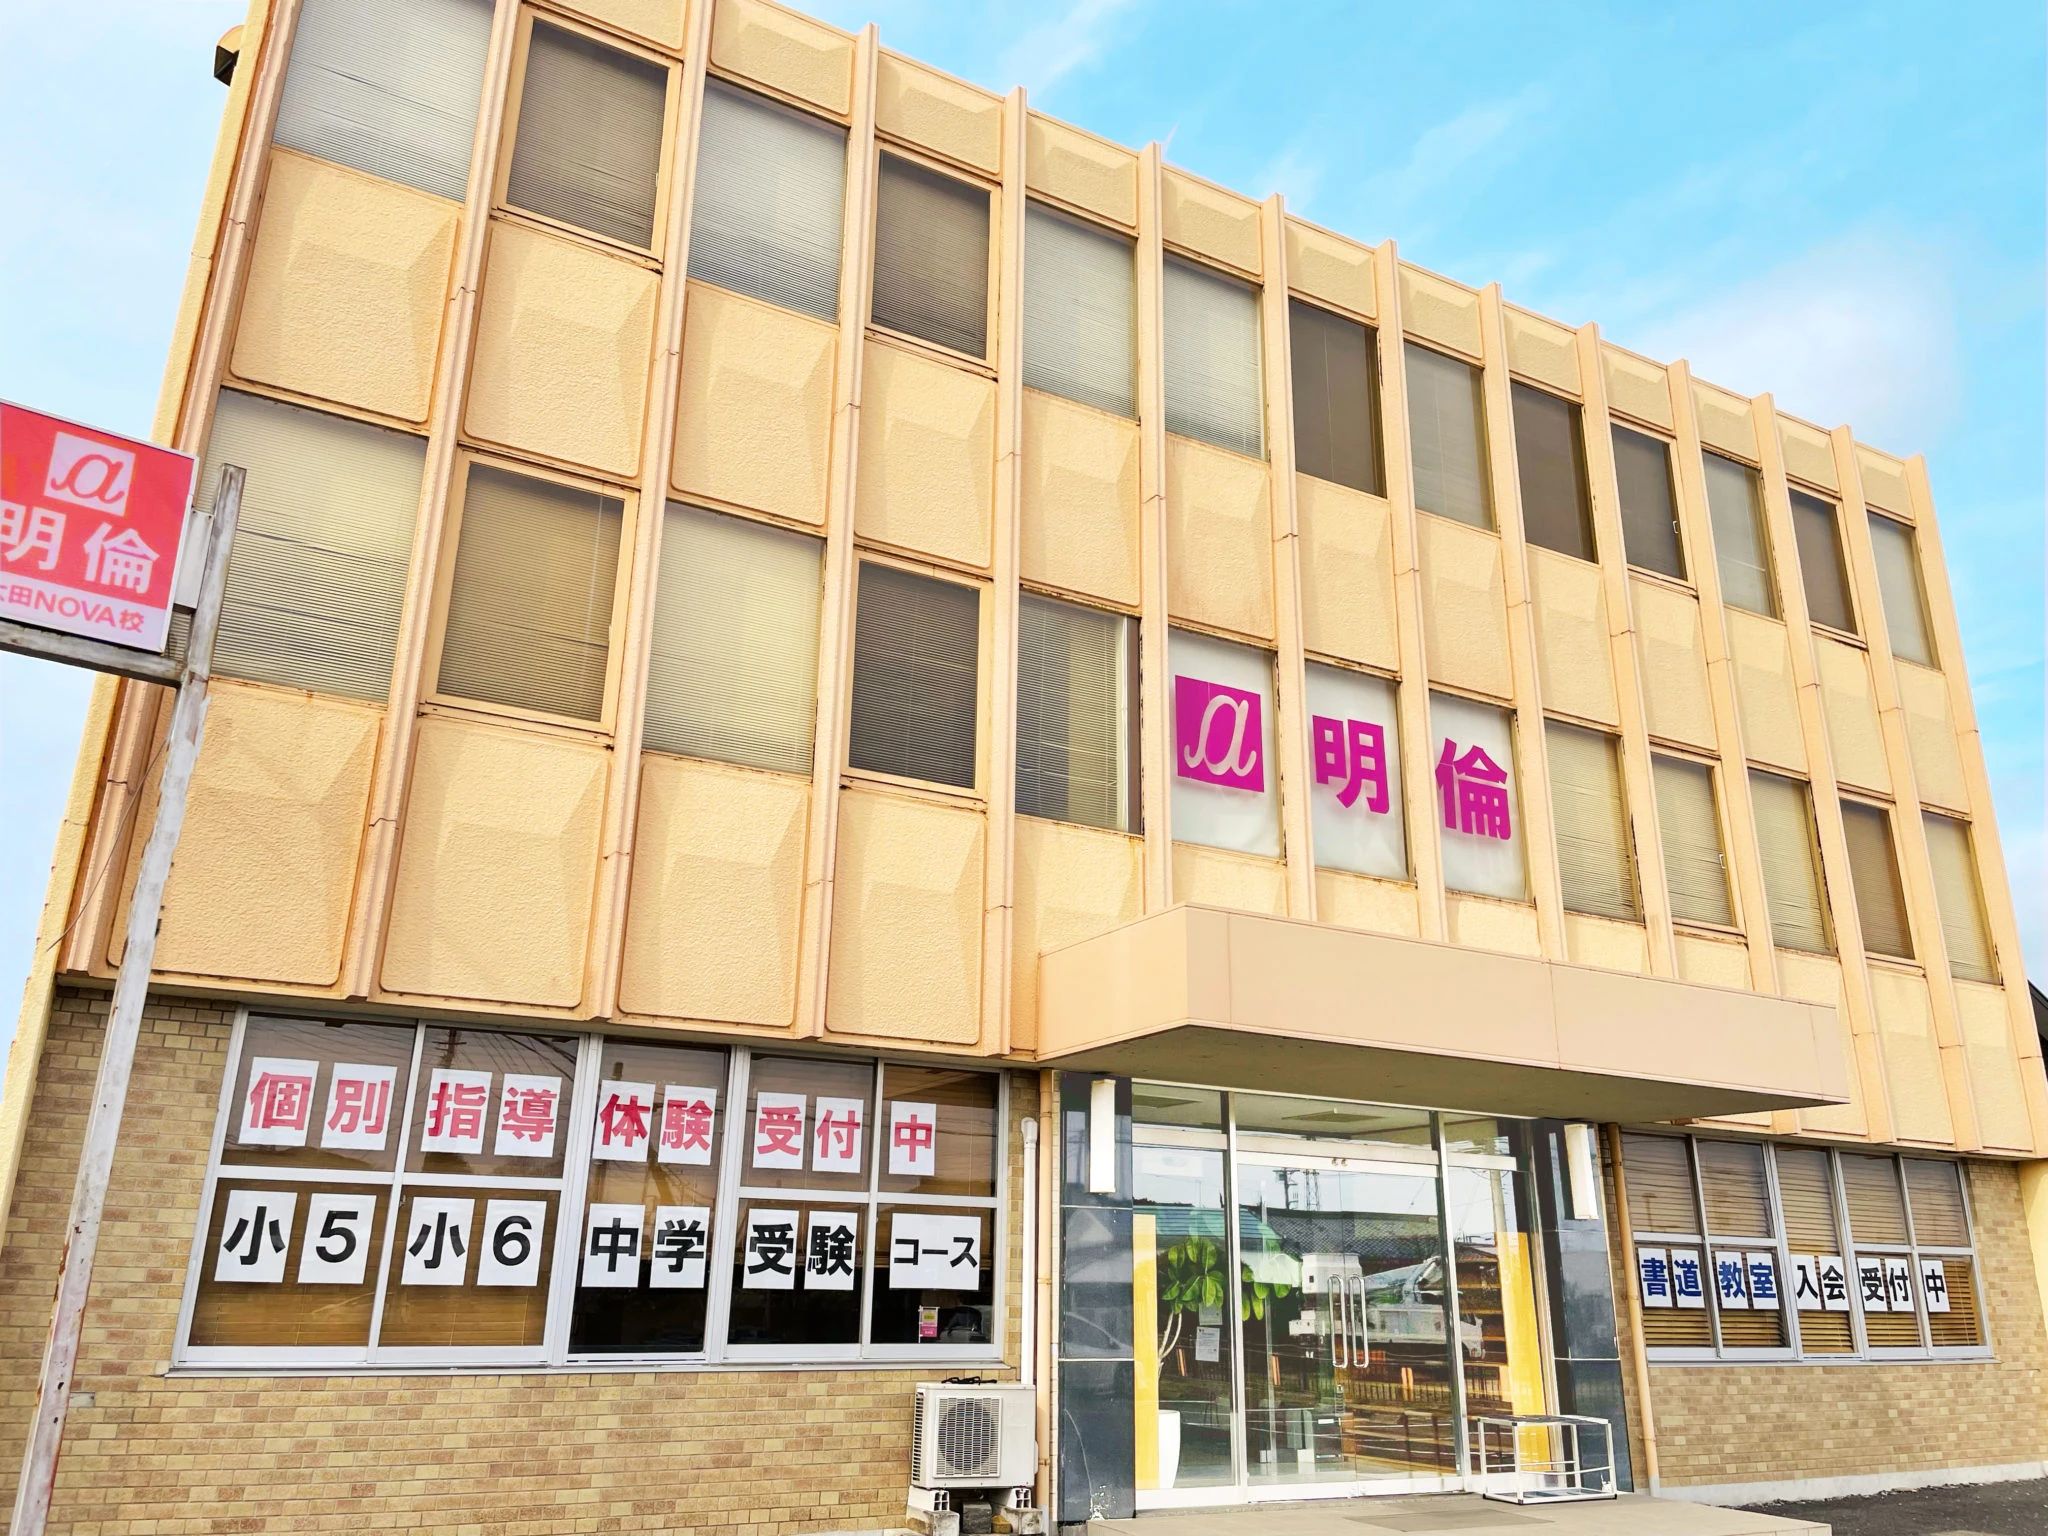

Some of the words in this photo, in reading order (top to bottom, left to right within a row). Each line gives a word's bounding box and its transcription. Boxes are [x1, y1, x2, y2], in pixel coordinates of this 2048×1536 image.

[0, 500, 161, 595] 明倫
[1312, 714, 1512, 841] 明倫
[249, 1070, 933, 1163] 個別指導体験受付中
